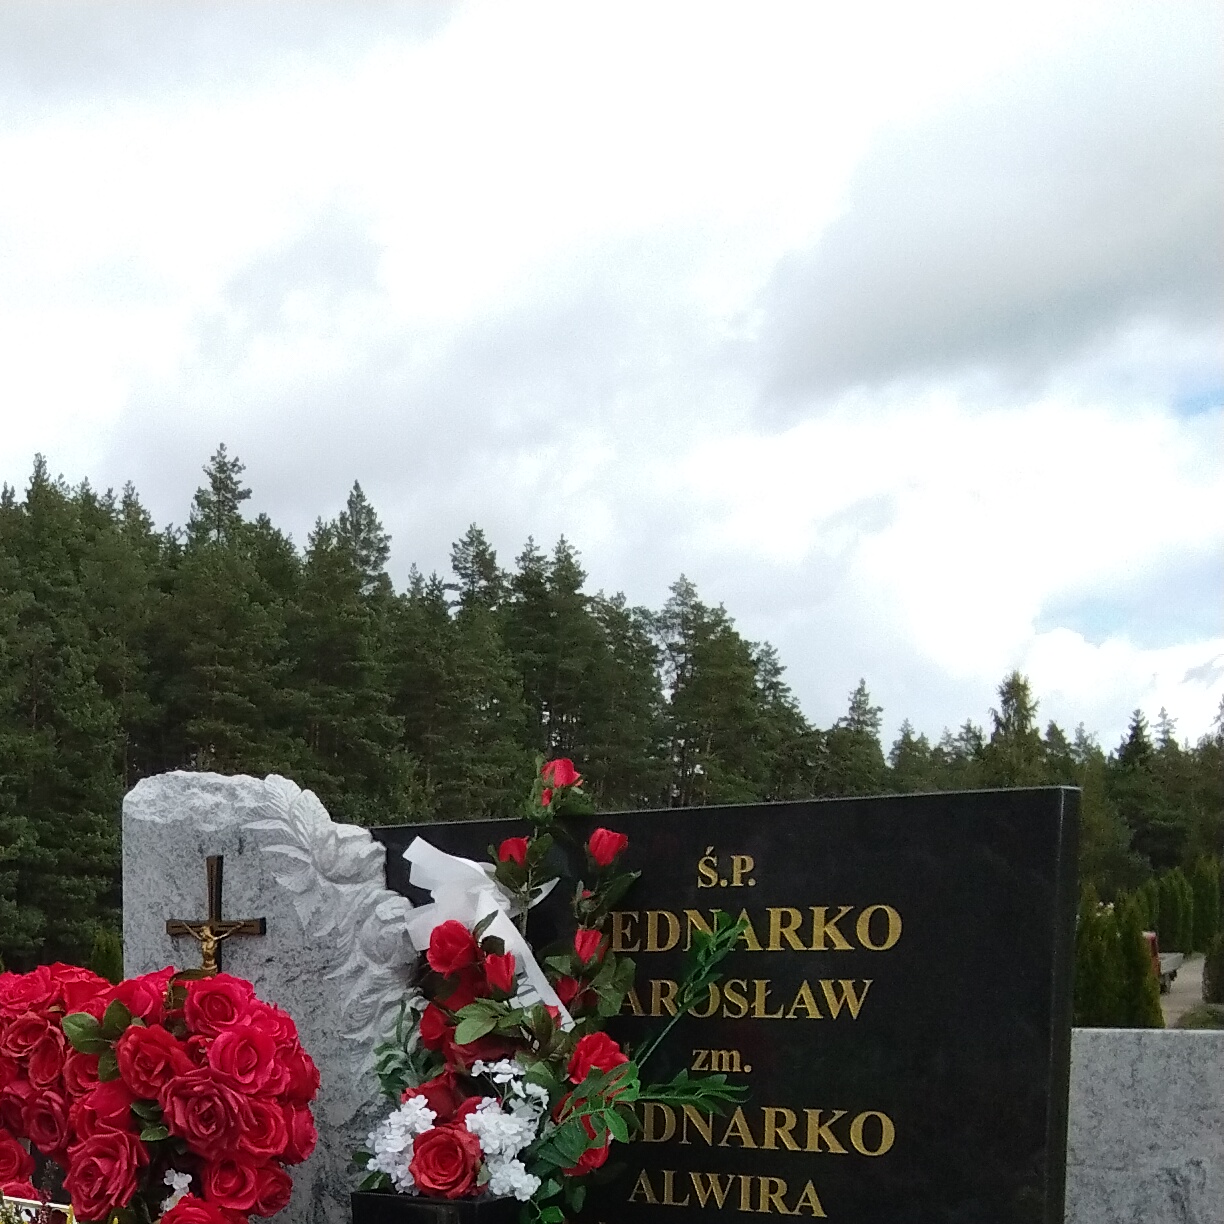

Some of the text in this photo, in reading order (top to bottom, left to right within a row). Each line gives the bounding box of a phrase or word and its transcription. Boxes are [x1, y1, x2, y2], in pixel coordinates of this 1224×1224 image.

[697, 847, 757, 888] Ś.P.
[609, 904, 903, 953] EDNARKO
[618, 978, 873, 1020] AROSŁAW
[691, 1049, 752, 1073] zm.
[631, 1101, 896, 1157] DNARKO
[627, 1168, 827, 1218] ALWIRA
